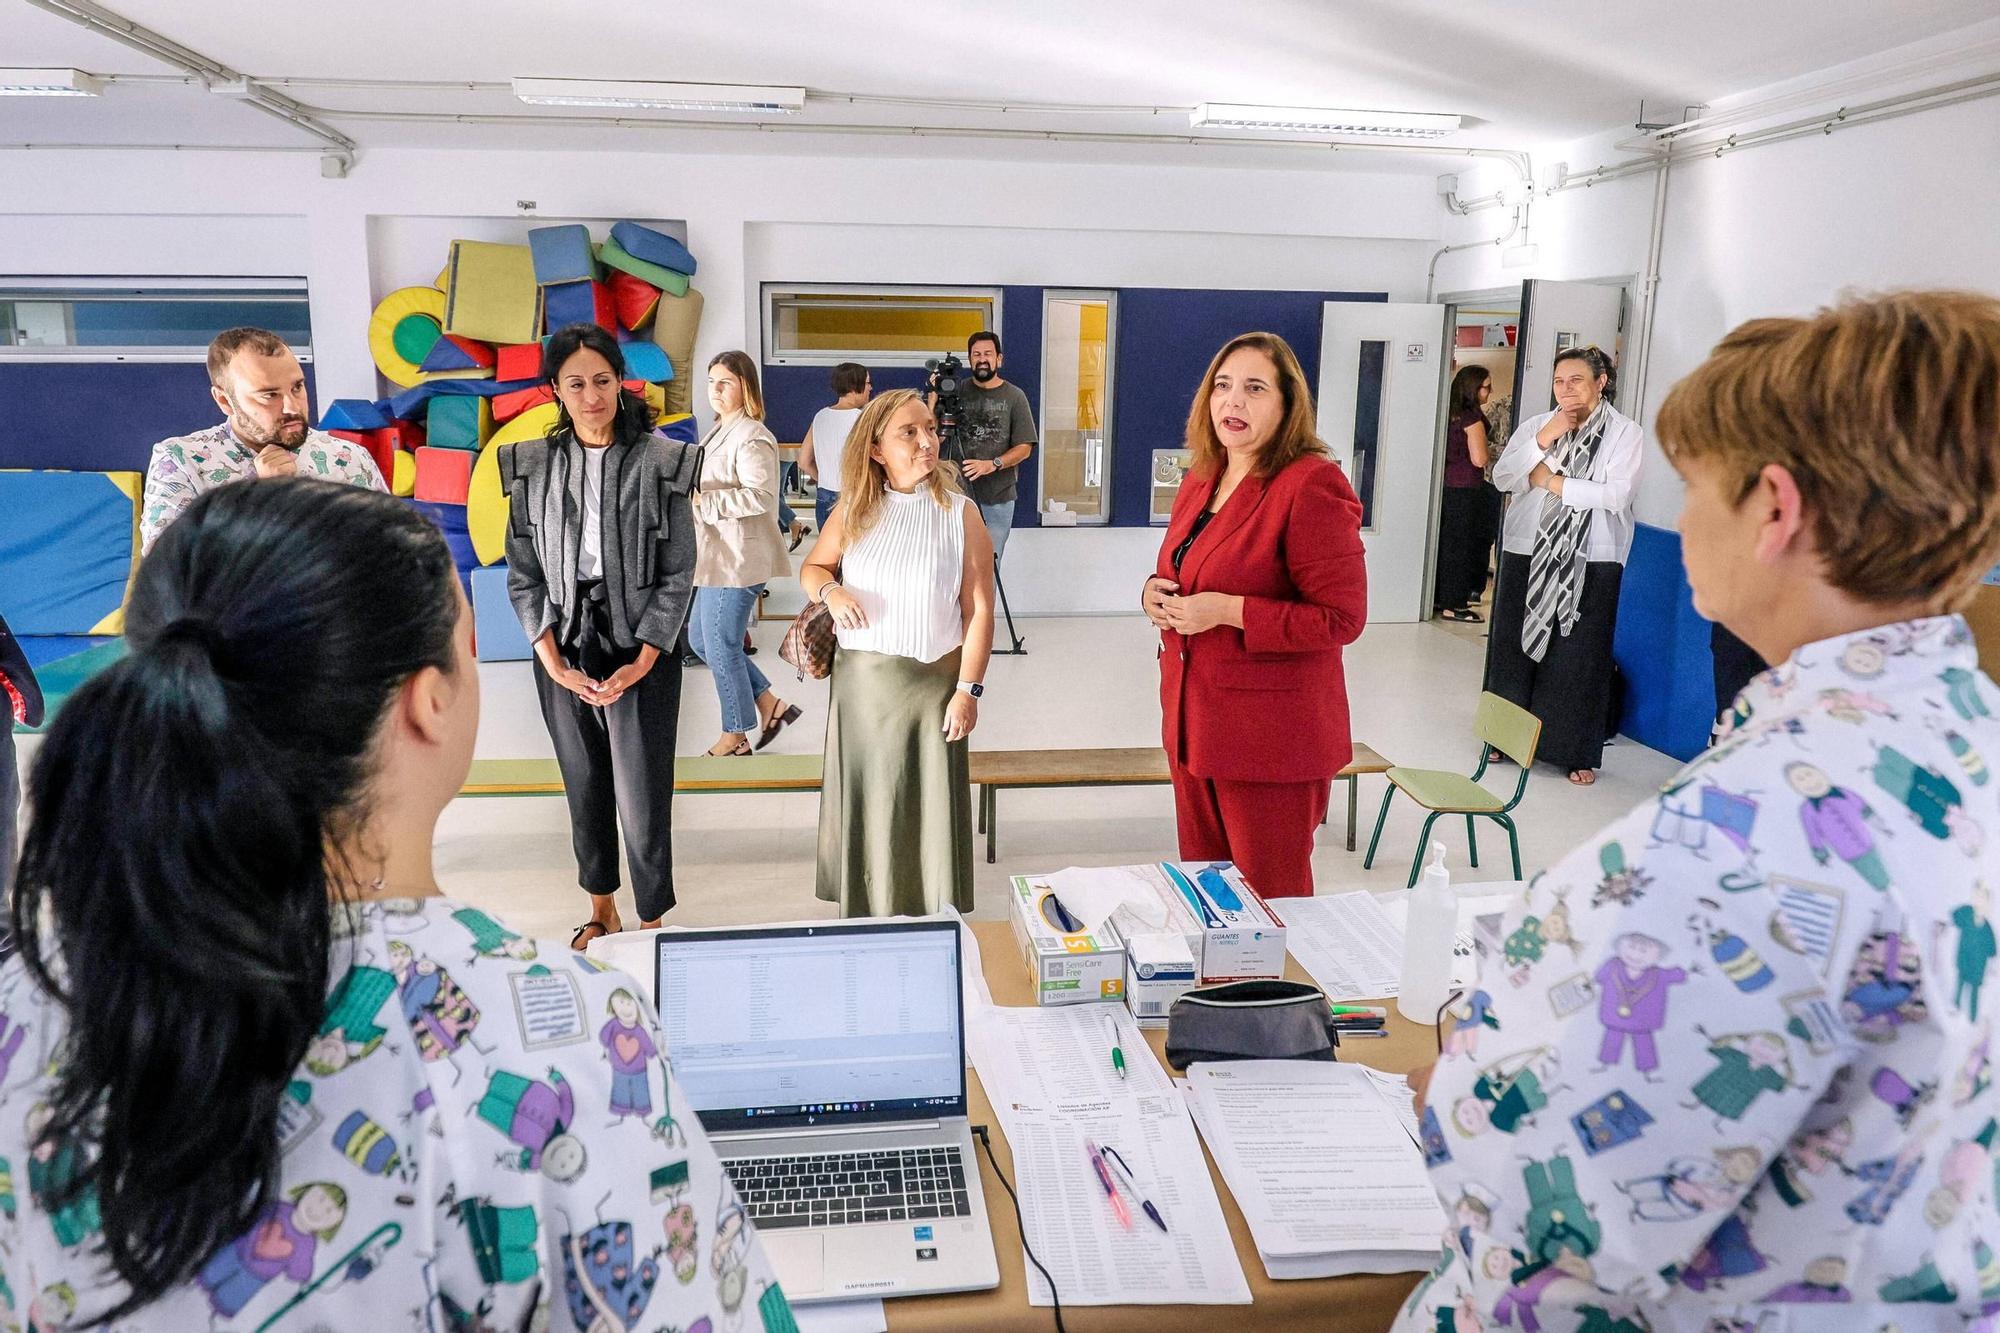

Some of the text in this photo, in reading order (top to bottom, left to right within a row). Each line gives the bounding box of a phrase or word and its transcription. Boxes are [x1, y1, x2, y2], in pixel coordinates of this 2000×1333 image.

[1065, 960, 1102, 969] SensiCare
[1066, 969, 1082, 977] Free
[1107, 981, 1116, 993] S
